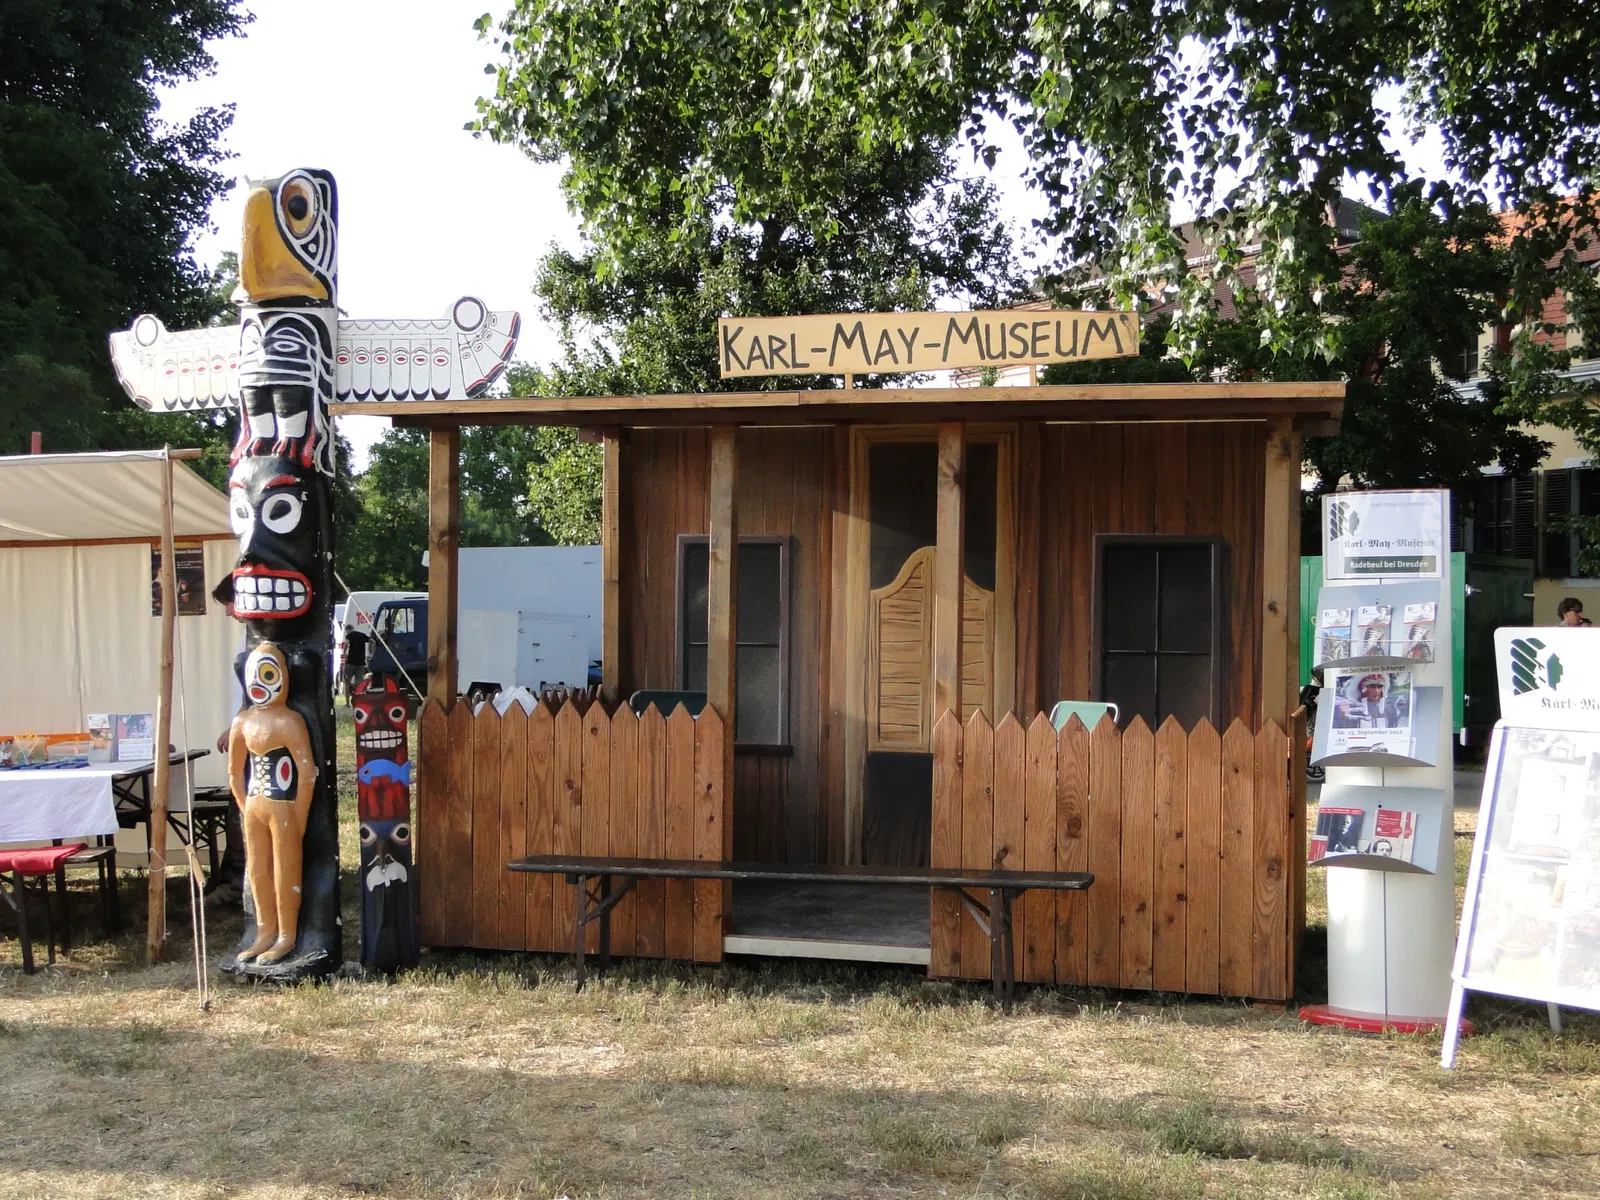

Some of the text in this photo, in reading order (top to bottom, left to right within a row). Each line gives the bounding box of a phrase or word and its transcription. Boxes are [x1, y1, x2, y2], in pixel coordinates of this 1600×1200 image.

[1349, 560, 1428, 569] Radebeul bei Dresden
[1381, 664, 1406, 672] Schlange
